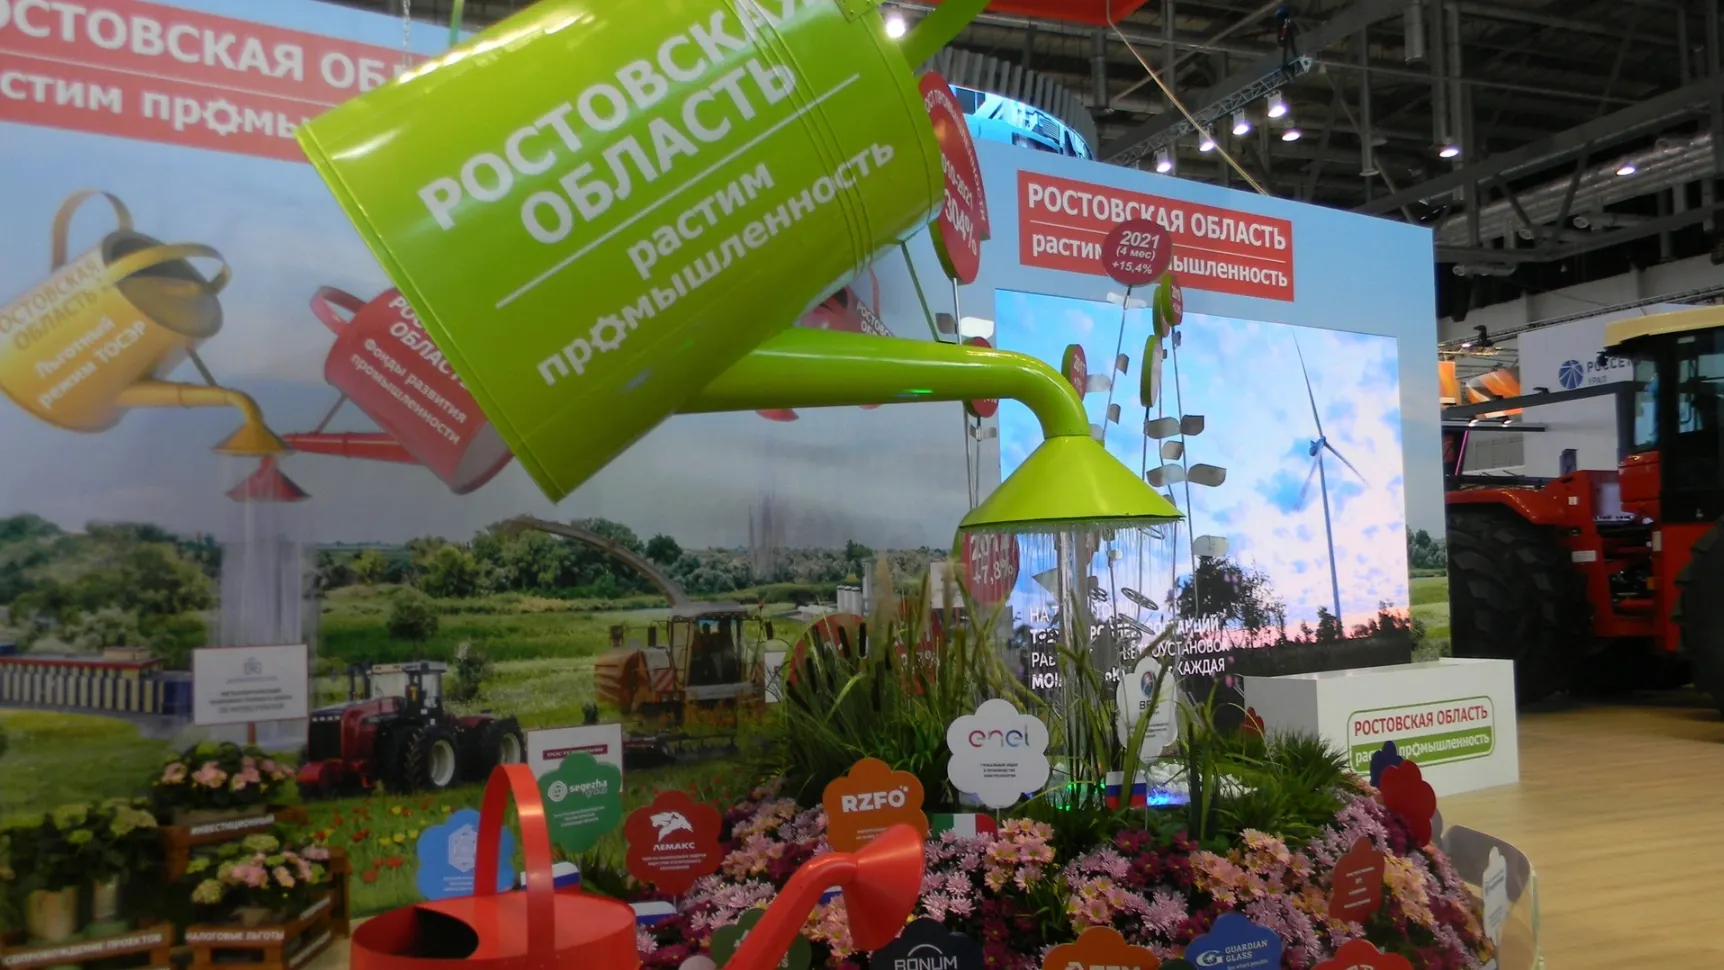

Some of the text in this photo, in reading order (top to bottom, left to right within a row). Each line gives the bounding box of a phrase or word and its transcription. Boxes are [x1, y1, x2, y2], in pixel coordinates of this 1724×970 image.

[321, 52, 408, 93] ОБ
[520, 58, 796, 245] ОБЛАСТЬ
[626, 162, 775, 281] растим
[944, 188, 977, 256] 304%
[1028, 183, 1287, 250] РОСТОВСКАЯ ОБЛАСТЬ
[1120, 231, 1160, 249] 2021
[536, 140, 895, 387] промышленность
[1112, 260, 1153, 275] +15,4%
[1130, 248, 1156, 261] мес)
[14, 290, 98, 351] ОБЛАСТЬ
[390, 321, 468, 390] ОБЛАС
[364, 338, 467, 424] Фонды развития
[351, 353, 461, 445] промышленности
[1354, 705, 1488, 736] РОСТОВСКАЯ ОБЛАСТЬ
[968, 724, 1030, 748] enel
[1398, 733, 1490, 757] промышленность
[569, 779, 608, 793] segezha
[841, 789, 905, 813] RZFO
[653, 842, 696, 851] ЛЕМАКС
[1225, 940, 1268, 954] GUARDIAN
[1226, 951, 1252, 962] GLASS
[894, 955, 958, 970] BONUM
